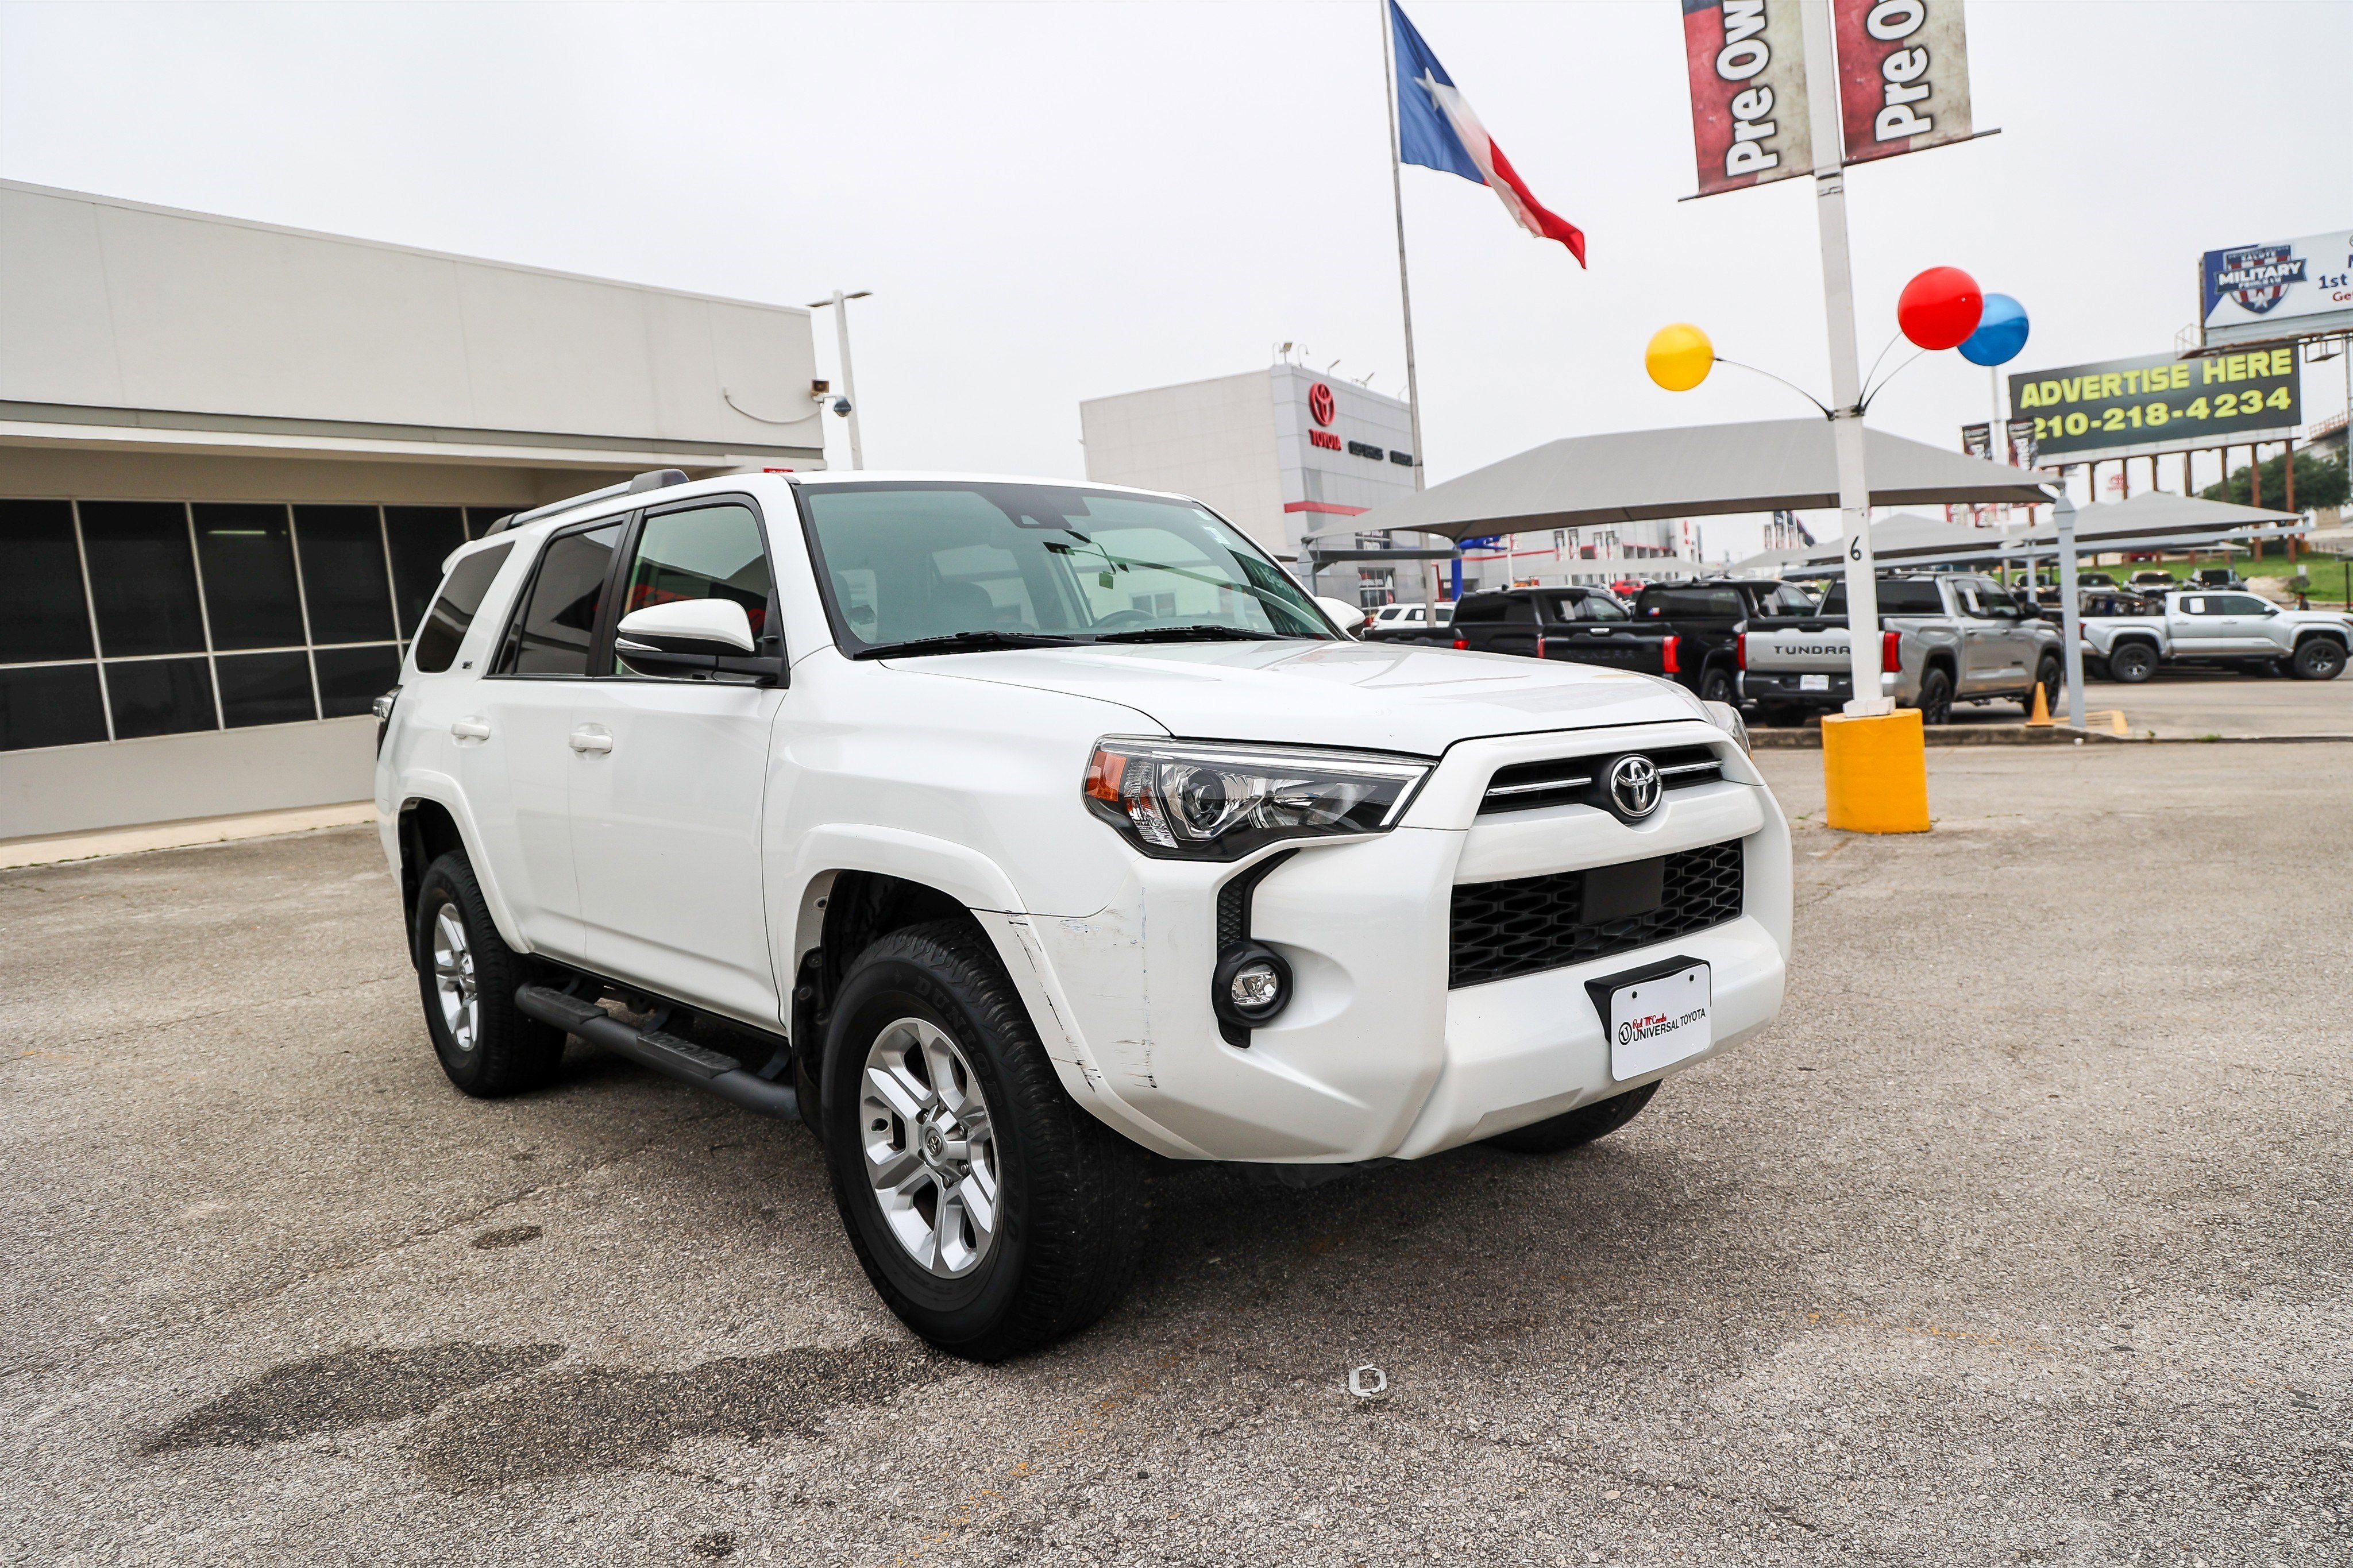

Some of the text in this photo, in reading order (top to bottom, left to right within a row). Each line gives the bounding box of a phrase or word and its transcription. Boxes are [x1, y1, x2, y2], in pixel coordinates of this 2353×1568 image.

[1875, 47, 1931, 141] Pre
[1726, 86, 1778, 177] Pre
[2218, 261, 2302, 286] MILITARY
[2319, 274, 2348, 289] 1st
[2019, 348, 2293, 410] ADVERTISE HERE
[1308, 428, 1343, 451] TOYOTA
[1850, 535, 1861, 562] 6
[1774, 646, 1850, 655] TUNDRA
[1633, 1018, 1643, 1030] Red
[1633, 1007, 1706, 1041] UNIVERSAL TOYOTA
[914, 974, 1004, 1108] DUNLOP
